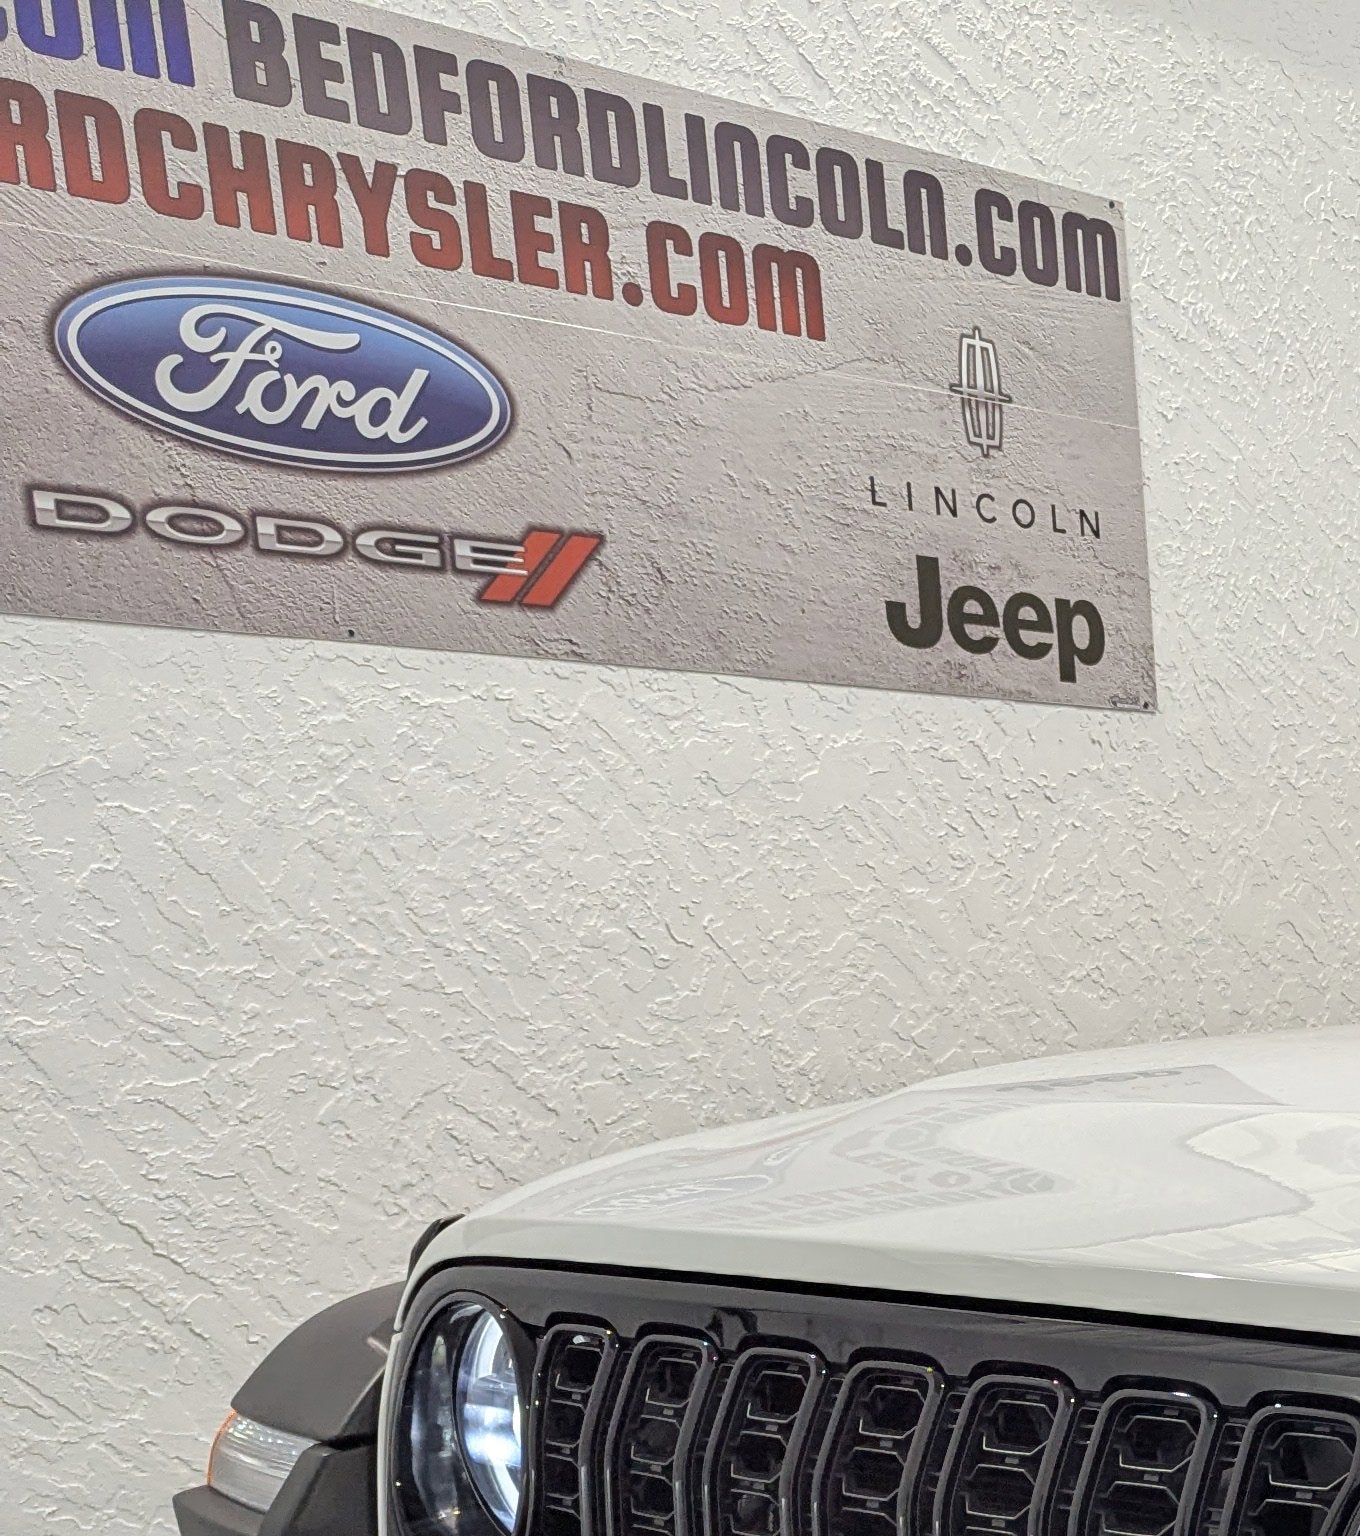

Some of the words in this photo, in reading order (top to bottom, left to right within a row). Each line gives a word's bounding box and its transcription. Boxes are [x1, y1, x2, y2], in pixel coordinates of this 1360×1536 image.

[222, 0, 1121, 301] BEDFORDLINCOLN.COM
[154, 303, 430, 444] Ford
[32, 490, 526, 575] DODGE
[868, 475, 1103, 539] LINCOLN
[885, 556, 1106, 681] Jeep
